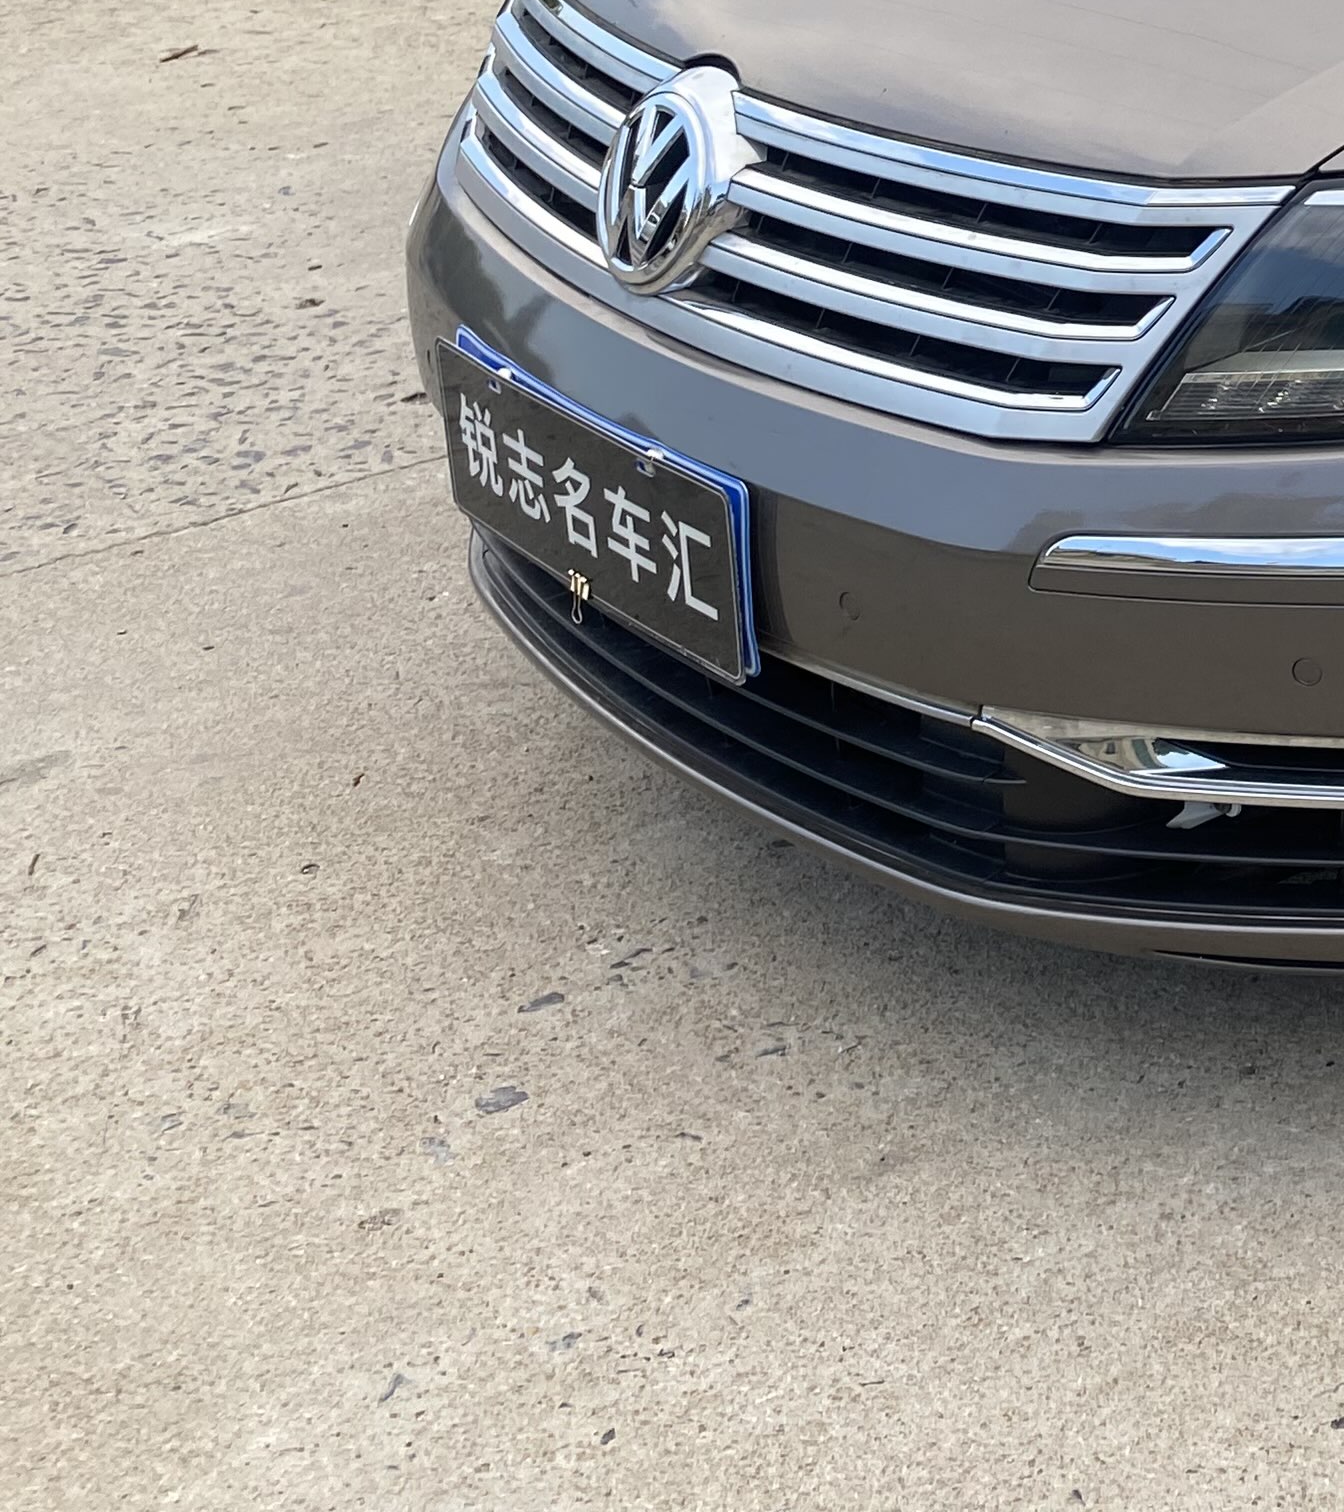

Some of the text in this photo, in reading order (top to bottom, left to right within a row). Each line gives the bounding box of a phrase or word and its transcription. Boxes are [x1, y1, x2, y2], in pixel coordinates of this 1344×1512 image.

[460, 394, 719, 622] 锐志名车汇
